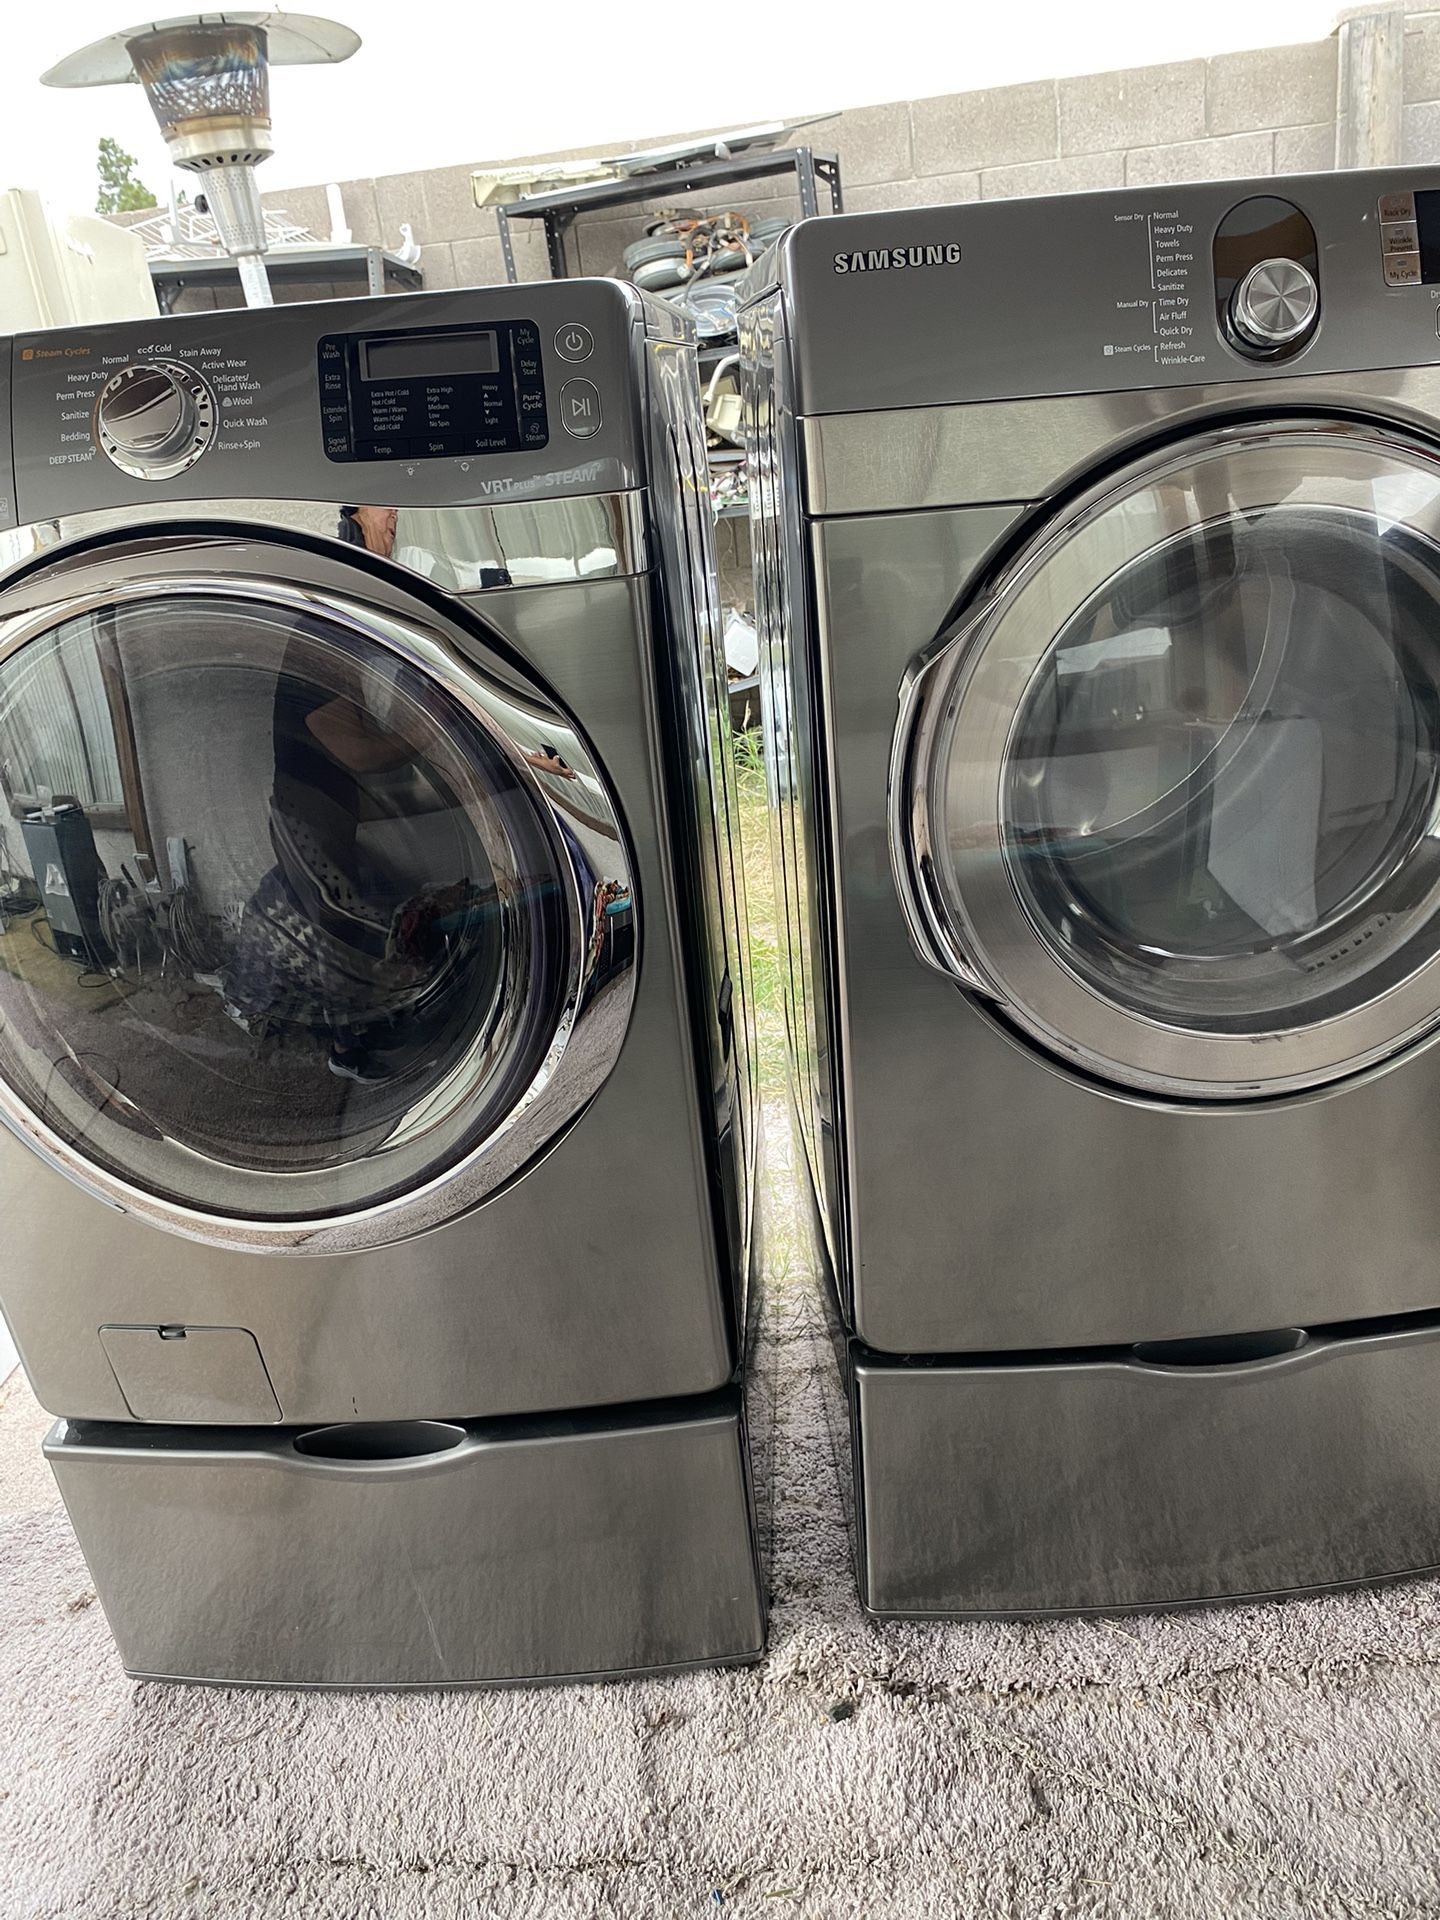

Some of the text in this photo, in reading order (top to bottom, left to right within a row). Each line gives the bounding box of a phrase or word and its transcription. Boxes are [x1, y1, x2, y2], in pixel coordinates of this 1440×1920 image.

[1114, 213, 1144, 222] Sensor Dry
[1153, 210, 1179, 220] Normal
[1154, 224, 1194, 234] Heavy Duty
[1155, 239, 1180, 248] Towels
[833, 243, 962, 274] SAMSUNG
[1156, 253, 1194, 263] Perm Press
[1157, 268, 1188, 277] Delicates
[1389, 270, 1418, 280] My Cycle
[1157, 282, 1185, 292] Sanitize
[1116, 299, 1149, 309] Manual Dry
[1159, 297, 1189, 306] Time Dry
[1159, 311, 1187, 321] Air Fluff
[519, 328, 530, 337] My
[1159, 326, 1193, 336] Quick Dry
[517, 335, 535, 346] Cycle
[1160, 341, 1186, 350] Refresh
[155, 344, 172, 353] Cold
[179, 347, 221, 357] Stain Away
[325, 343, 336, 351] Pre
[1114, 344, 1151, 353] Steam Cycles
[35, 347, 91, 358] Steam Cycles
[322, 350, 340, 359] Wash
[102, 355, 129, 365] Normal
[201, 359, 247, 370] Active Wear
[520, 360, 537, 369] Delay
[1161, 354, 1206, 365] Wrinkle-Care
[523, 367, 537, 375] Start
[68, 371, 109, 383] Heavy Duty
[212, 373, 250, 384] Delicates/
[324, 374, 341, 382] Extra
[218, 381, 261, 392] Hand Wash
[325, 381, 342, 390] Rinse
[440, 386, 453, 394] High
[482, 384, 499, 392] Heavy
[56, 389, 95, 401] Perm Press
[427, 395, 439, 403] High
[232, 396, 253, 406] Wool
[323, 406, 347, 415] Extended
[522, 402, 543, 411] Cycle
[61, 410, 89, 421] Sanitize
[328, 414, 342, 423] Spin
[222, 417, 268, 429] Quick Wash
[484, 417, 499, 425] Light
[61, 432, 90, 442] Bedding
[327, 436, 346, 446] Signal
[525, 434, 546, 442] Steam
[218, 440, 261, 451] Rinse+Spin
[428, 442, 444, 451] Spin
[475, 437, 507, 448] Soil Level
[327, 444, 348, 453] On/Off
[373, 446, 393, 455] Temp.
[49, 453, 92, 465] DEEP STEAM
[481, 478, 513, 495] VRT
